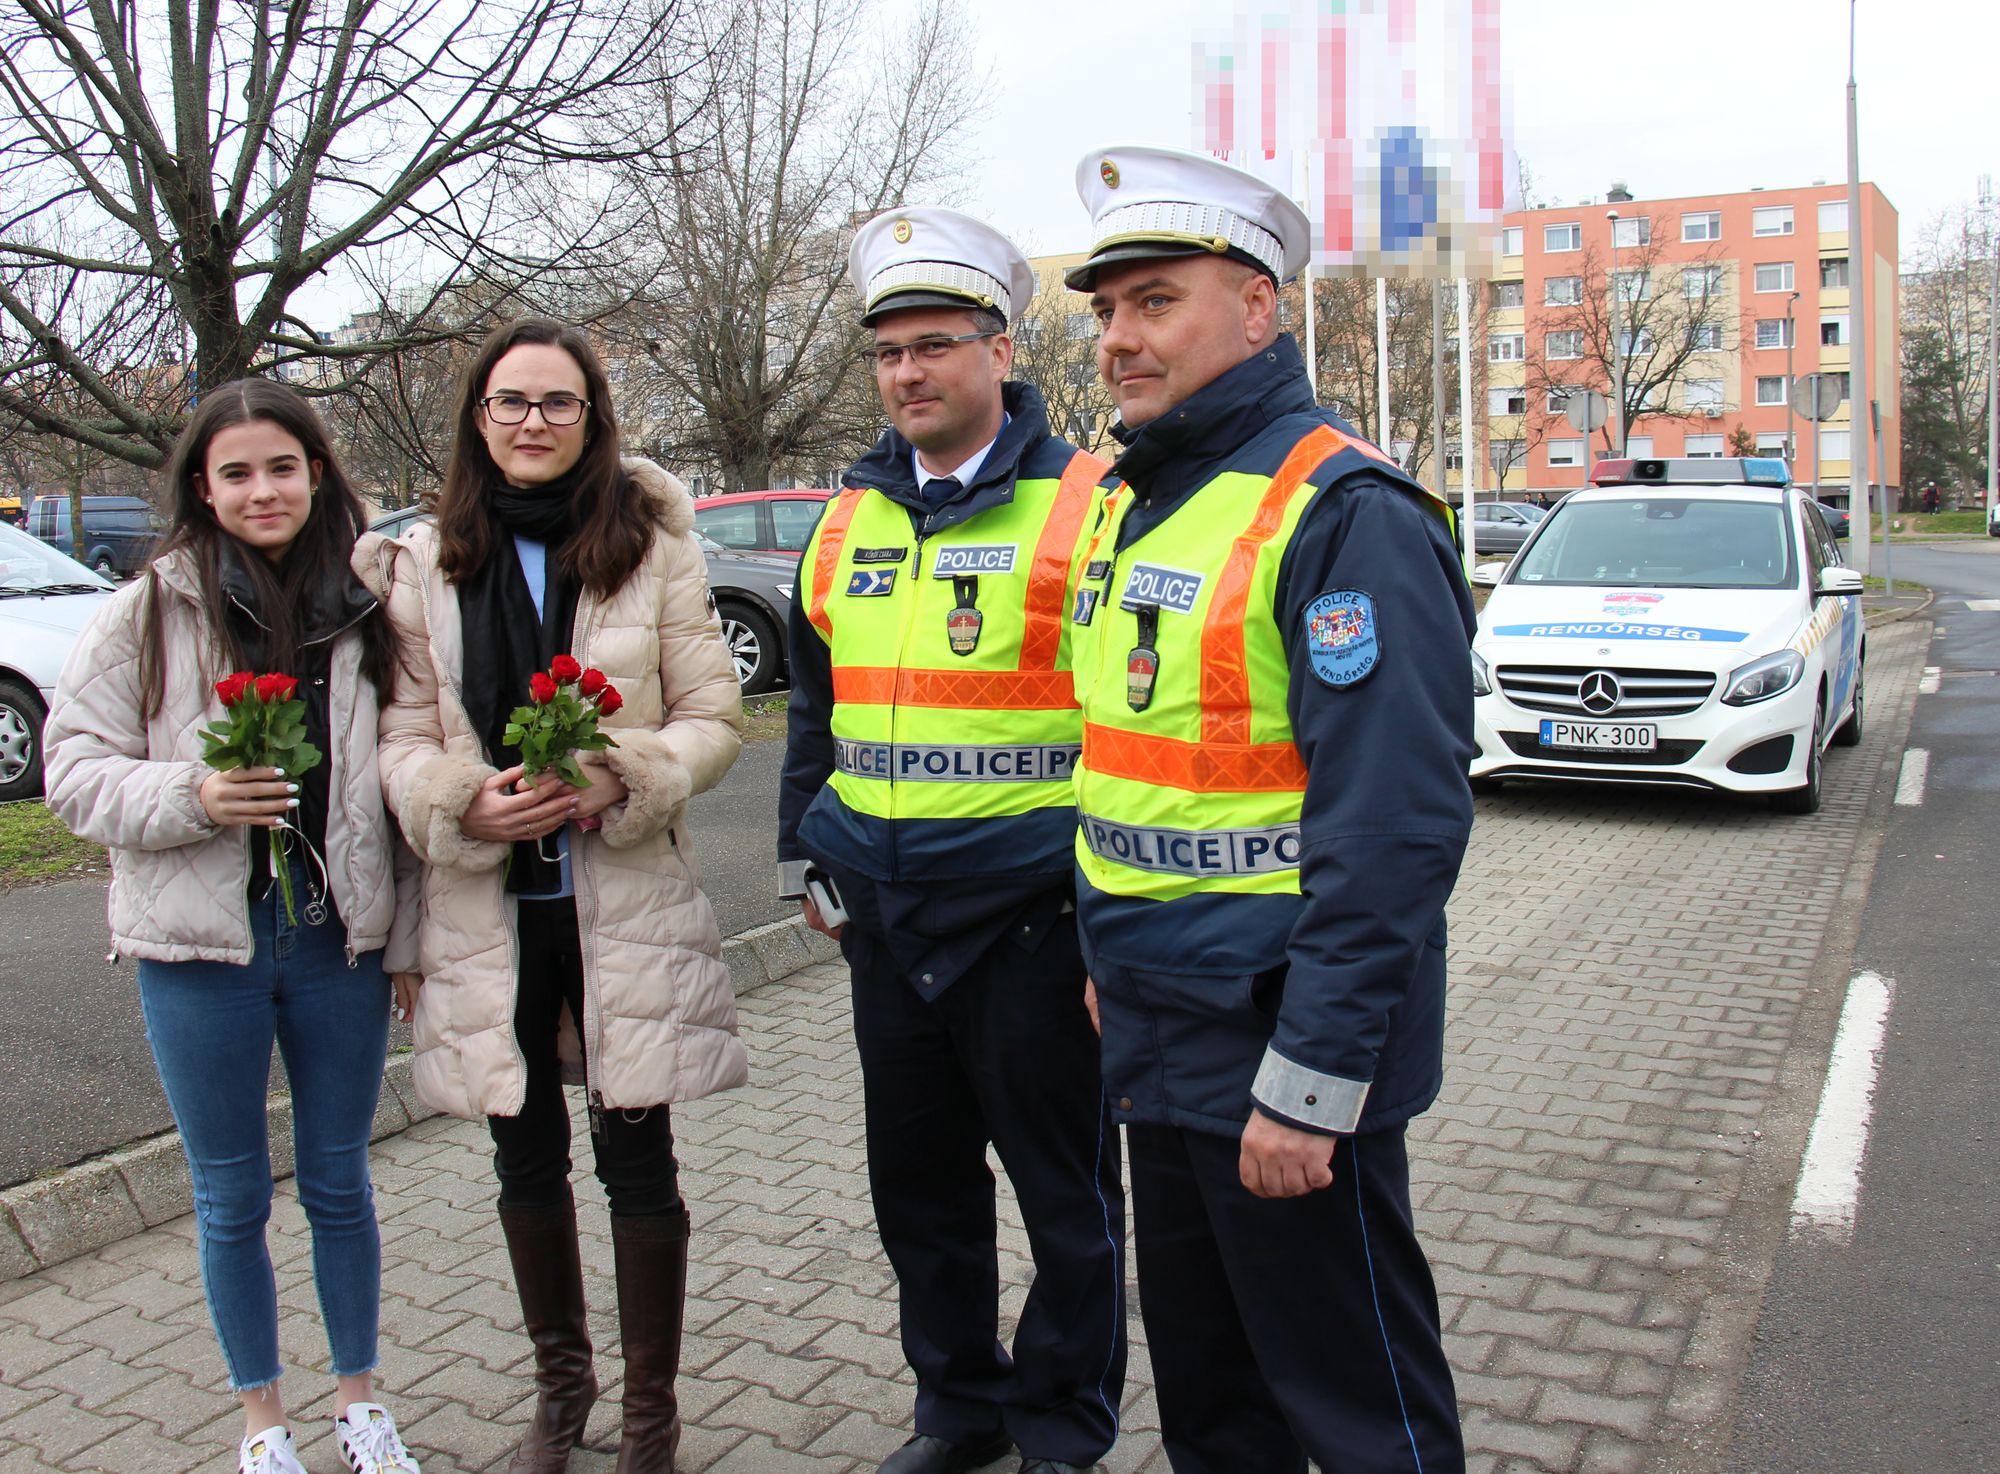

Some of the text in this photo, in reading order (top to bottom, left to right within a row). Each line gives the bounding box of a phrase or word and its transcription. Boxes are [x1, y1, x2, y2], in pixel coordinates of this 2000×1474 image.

[937, 551, 1012, 569] POLICE
[1127, 571, 1197, 606] POLICE
[1313, 593, 1360, 614] POLICE
[1529, 622, 1702, 641] RENDŐRSÉG
[1319, 655, 1373, 682] RENDŐRSÉG
[1556, 724, 1650, 746] PNK-300
[835, 742, 888, 773] OLICE
[901, 750, 1033, 776] POLICE
[1093, 823, 1222, 869] POLICE
